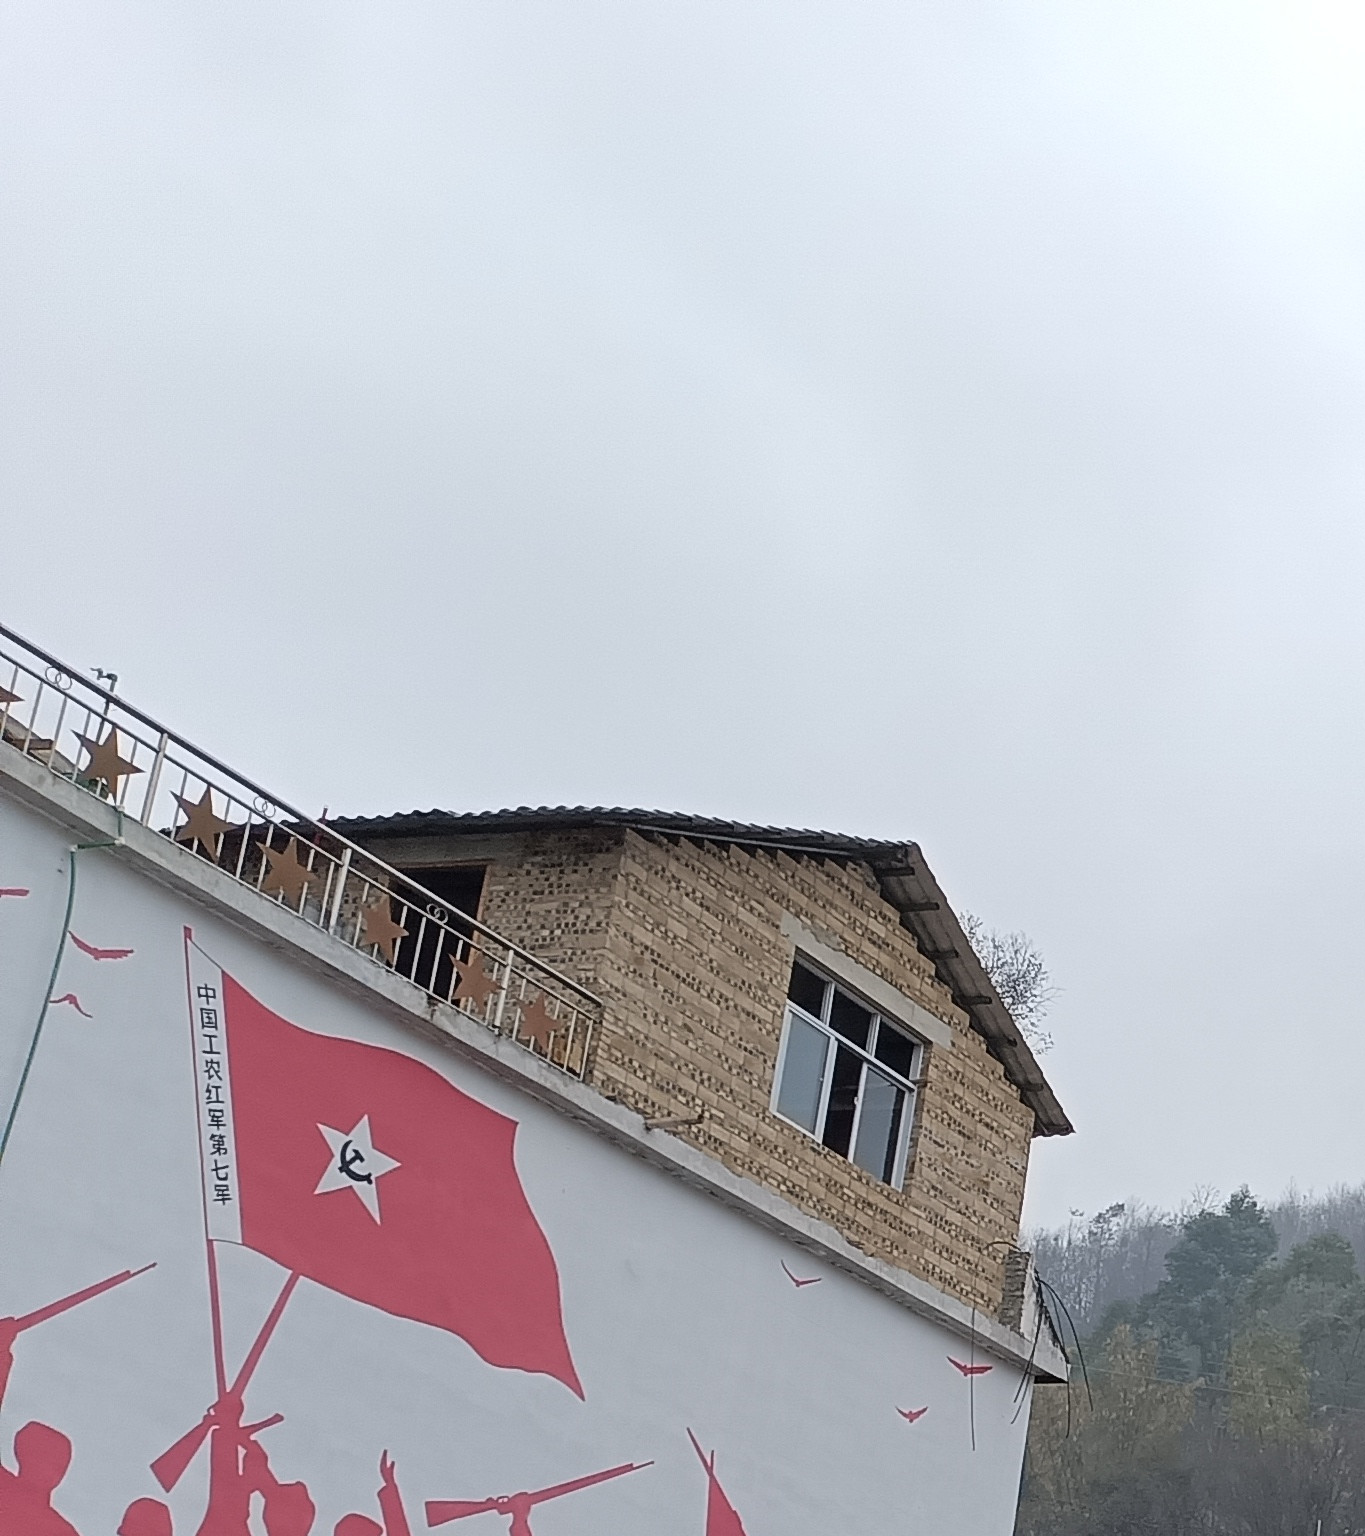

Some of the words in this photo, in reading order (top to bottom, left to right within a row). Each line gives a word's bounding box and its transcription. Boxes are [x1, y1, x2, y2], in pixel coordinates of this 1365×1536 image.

[197, 983, 233, 1206] 中国工农红军第七军
